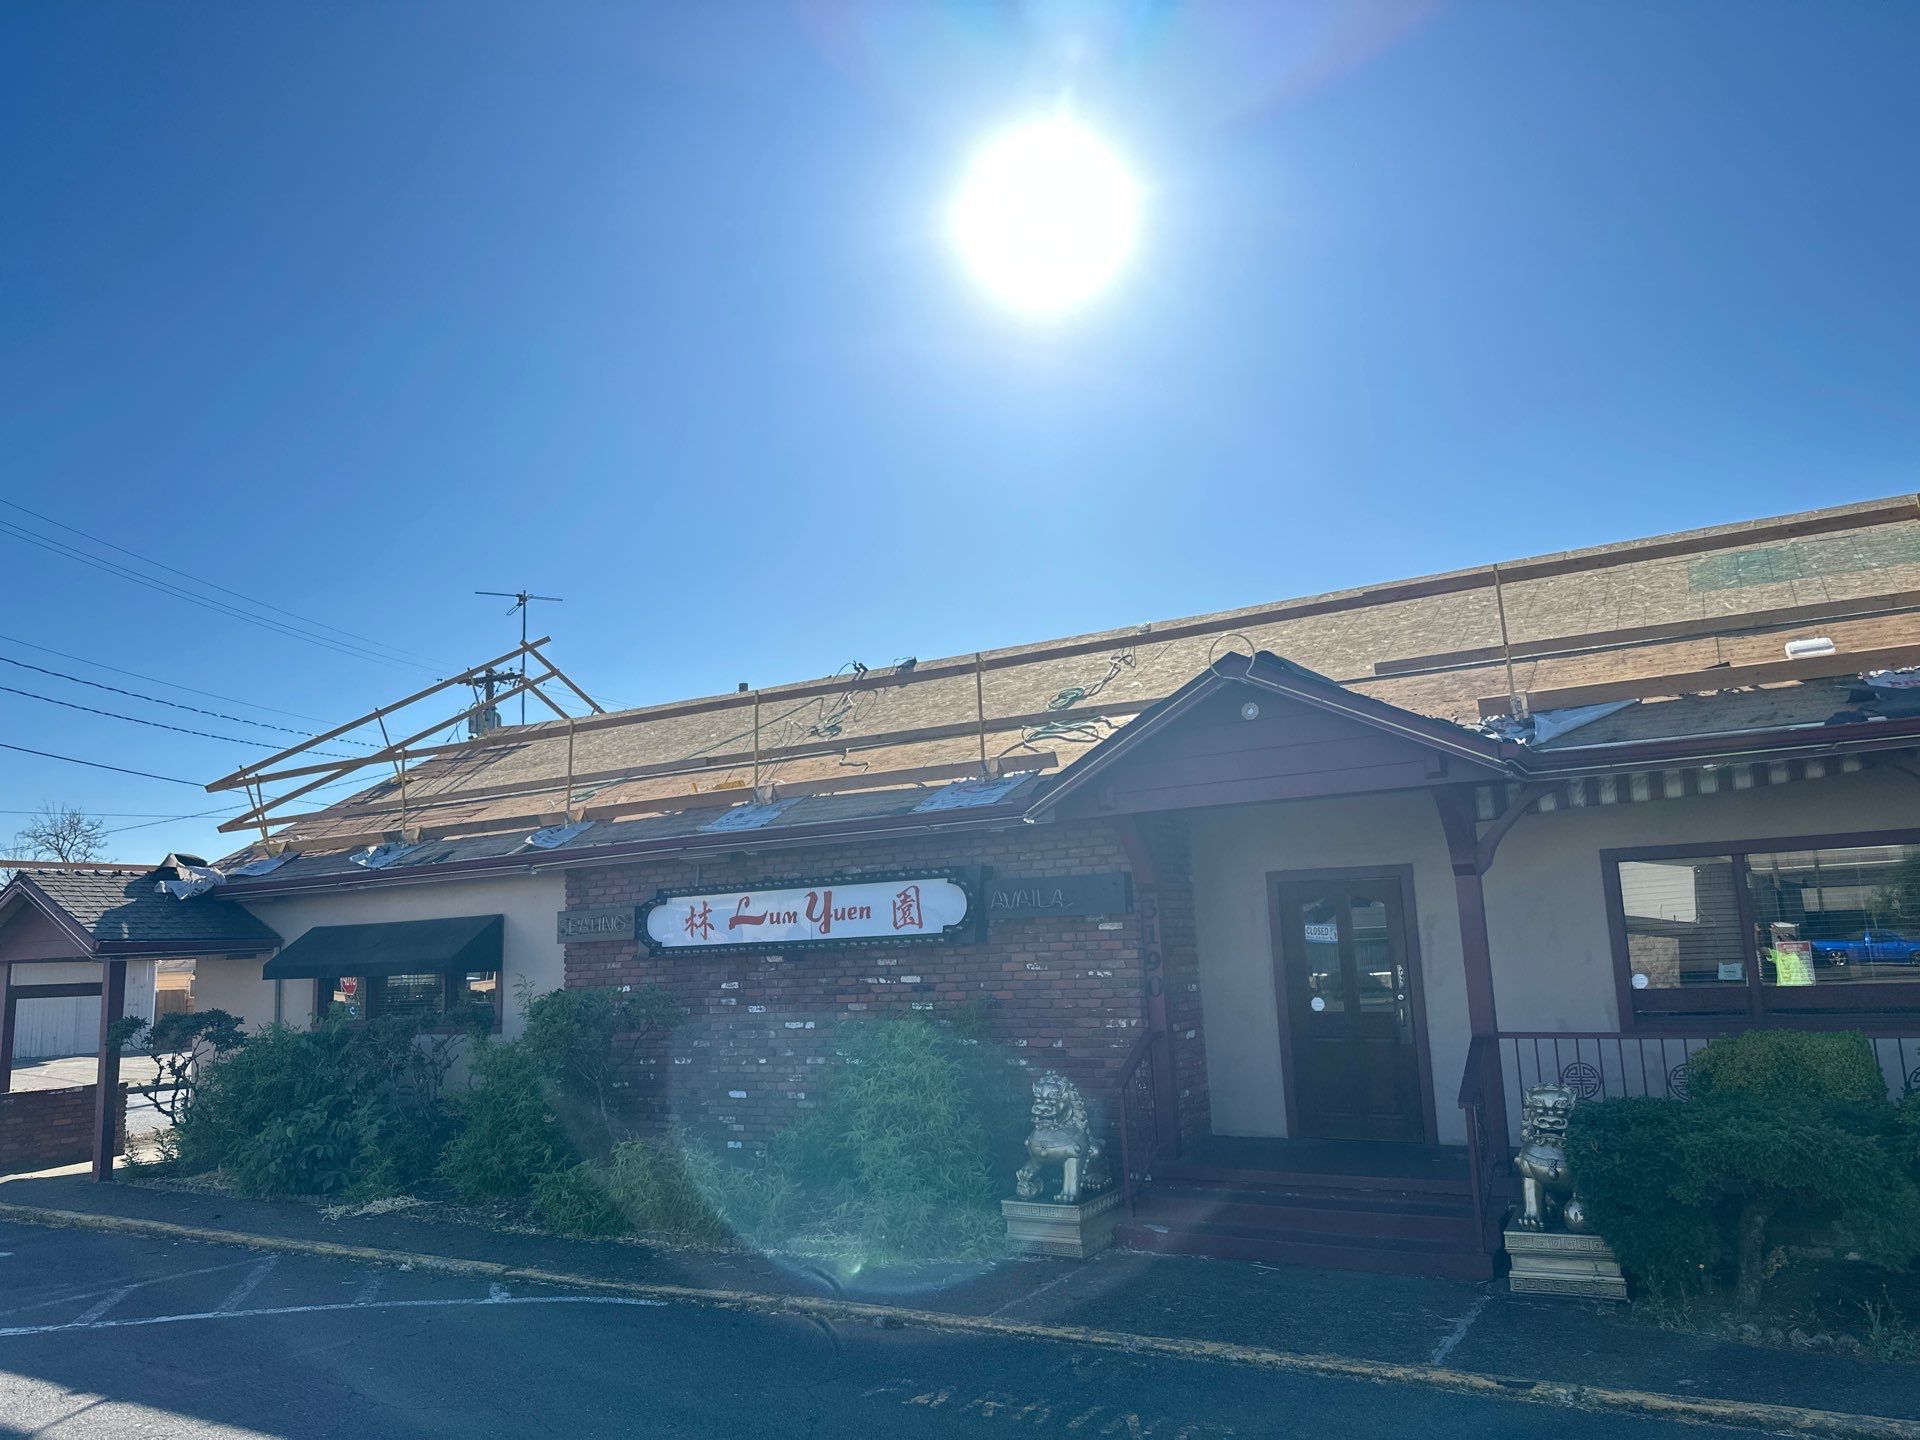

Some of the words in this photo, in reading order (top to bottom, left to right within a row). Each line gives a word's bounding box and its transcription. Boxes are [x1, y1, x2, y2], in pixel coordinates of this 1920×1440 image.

[684, 900, 715, 941] 林
[728, 896, 798, 931] Lum
[803, 890, 872, 935] Yuen
[1306, 926, 1329, 936] CLOSED
